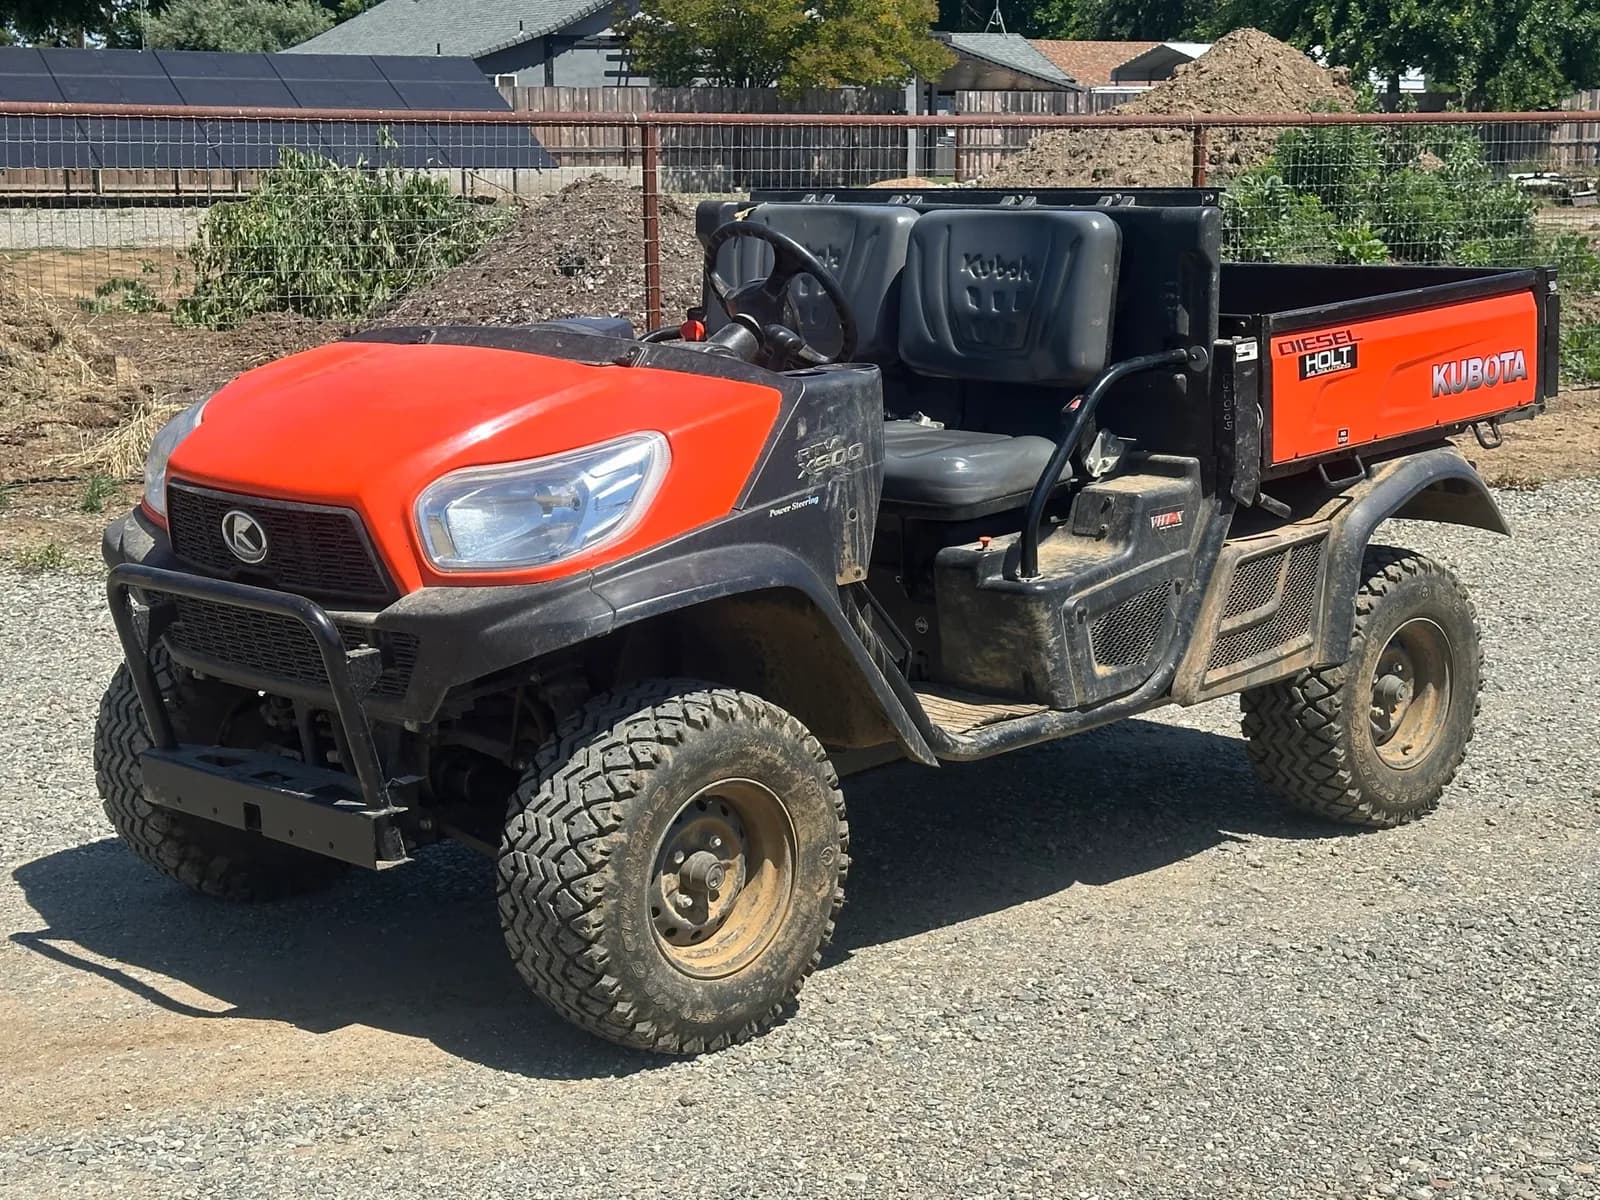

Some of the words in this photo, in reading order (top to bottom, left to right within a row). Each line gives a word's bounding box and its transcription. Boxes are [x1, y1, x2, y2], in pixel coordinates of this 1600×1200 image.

[1278, 329, 1363, 356] DIESEL
[1305, 346, 1352, 372] HOLT
[1432, 349, 1528, 398] KUBOTA
[769, 504, 792, 518] Power
[791, 495, 820, 511] Steering
